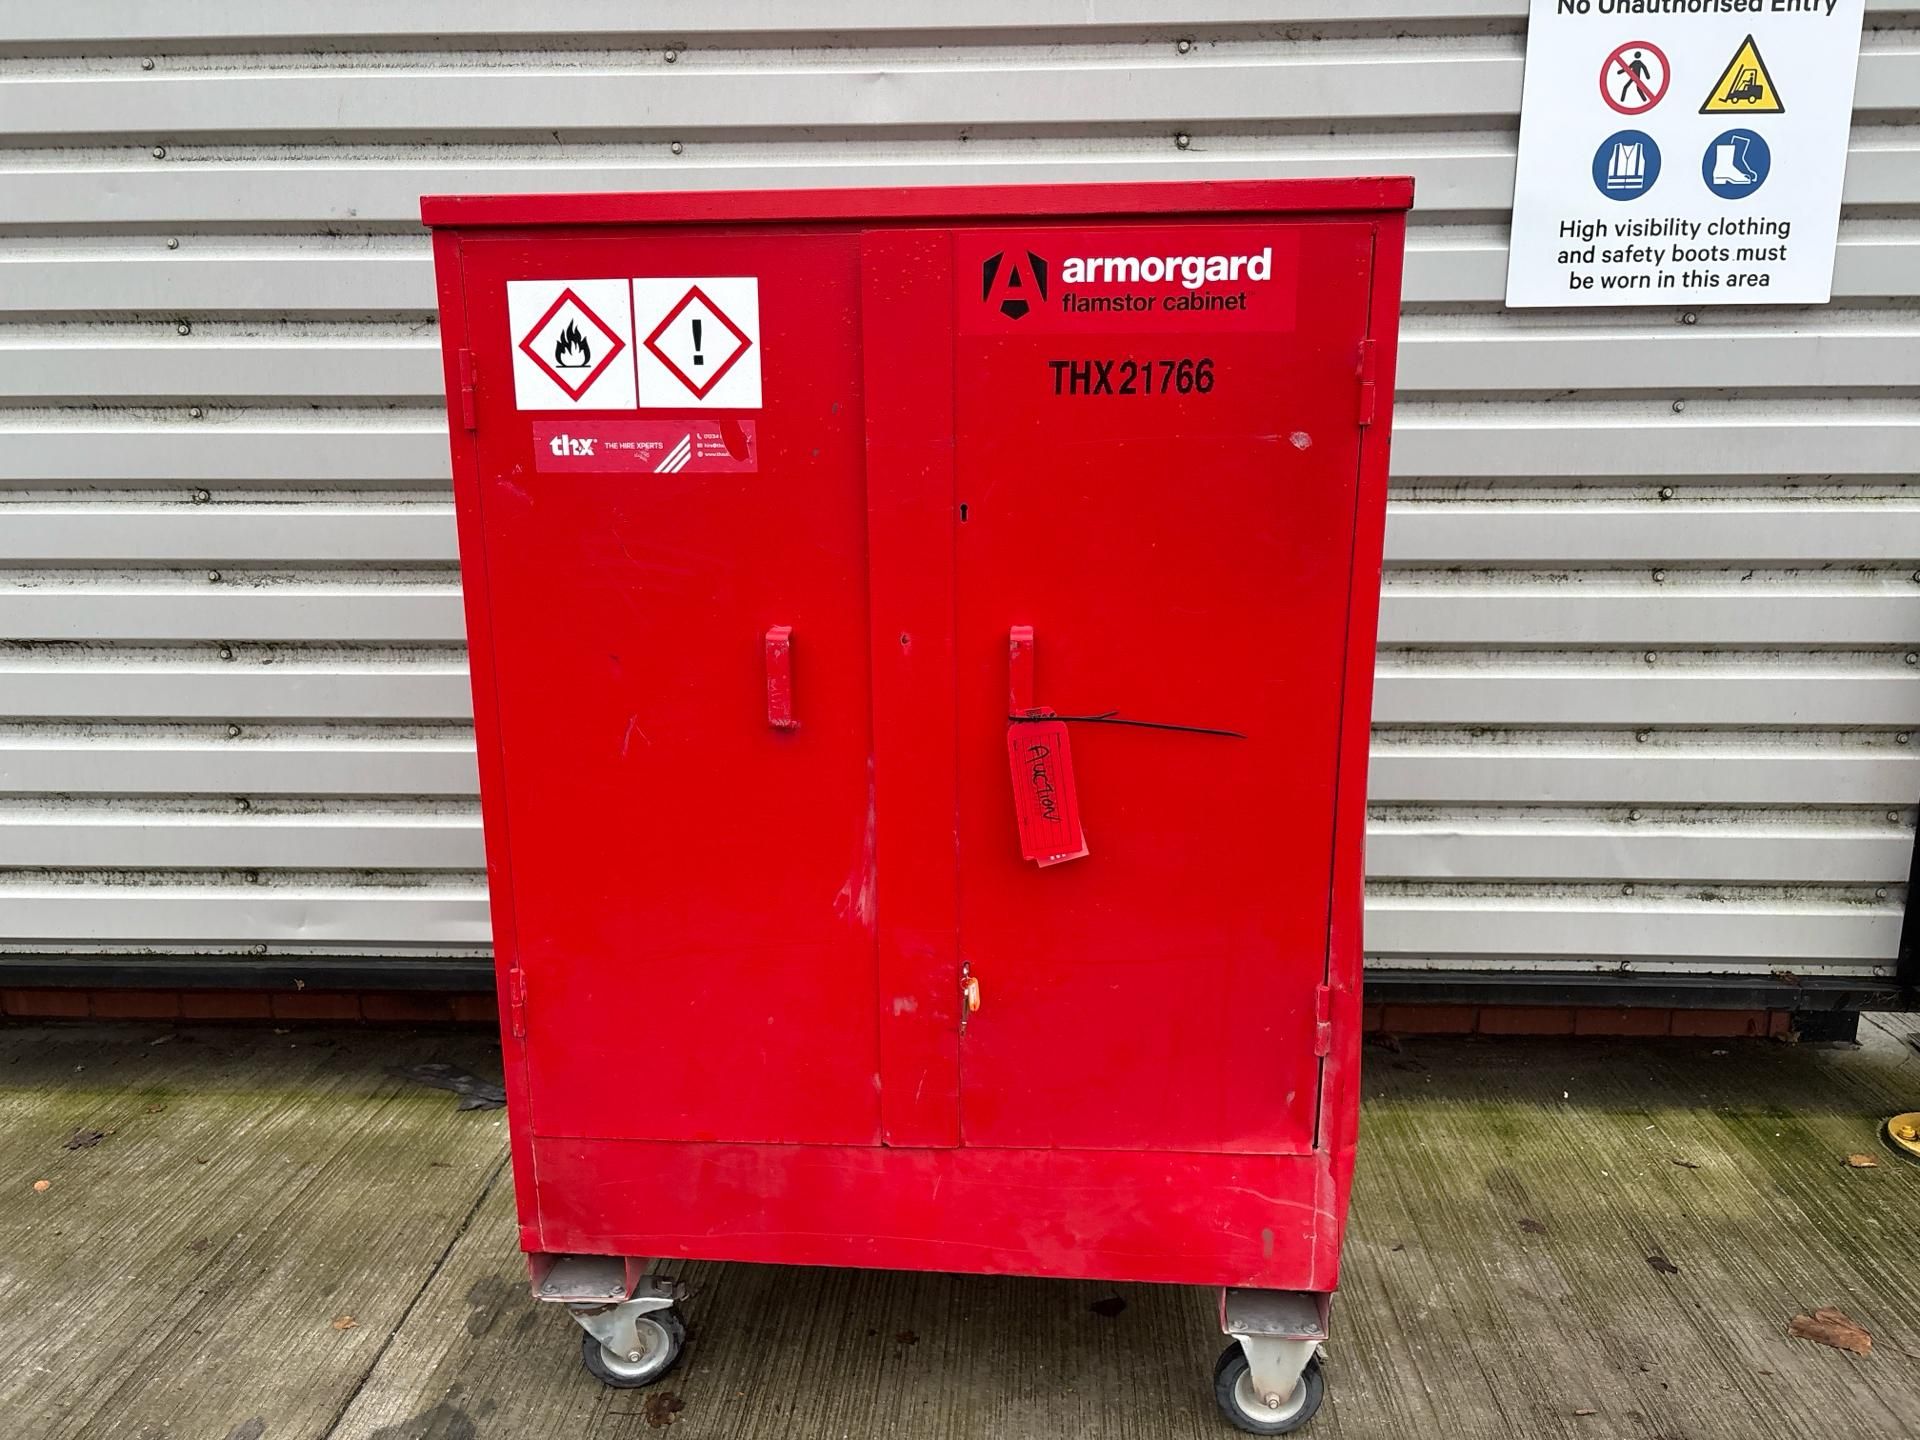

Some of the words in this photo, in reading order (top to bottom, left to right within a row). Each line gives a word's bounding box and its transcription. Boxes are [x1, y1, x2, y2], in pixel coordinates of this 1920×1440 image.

[1557, 0, 1591, 15] No
[1598, 0, 1763, 14] Unauthorised
[1771, 0, 1837, 17] Entry
[1559, 218, 1608, 243] High
[1614, 217, 1702, 241] visibility
[1707, 216, 1791, 240] clothing
[1557, 244, 1596, 264] and
[1601, 244, 1666, 267] safety
[1671, 243, 1730, 262] boots
[1736, 244, 1787, 261] must
[1062, 247, 1272, 289] armorgard
[1569, 271, 1594, 290] be
[1600, 275, 1651, 289] worn
[1657, 270, 1675, 288] in
[1681, 269, 1720, 288] this
[1726, 273, 1770, 288] area
[1062, 293, 1155, 313] flamstor
[1162, 291, 1247, 312] cabinet
[549, 433, 595, 457] thx
[604, 442, 618, 450] THE
[619, 442, 635, 450] HIRE
[637, 442, 664, 450] XPERTS
